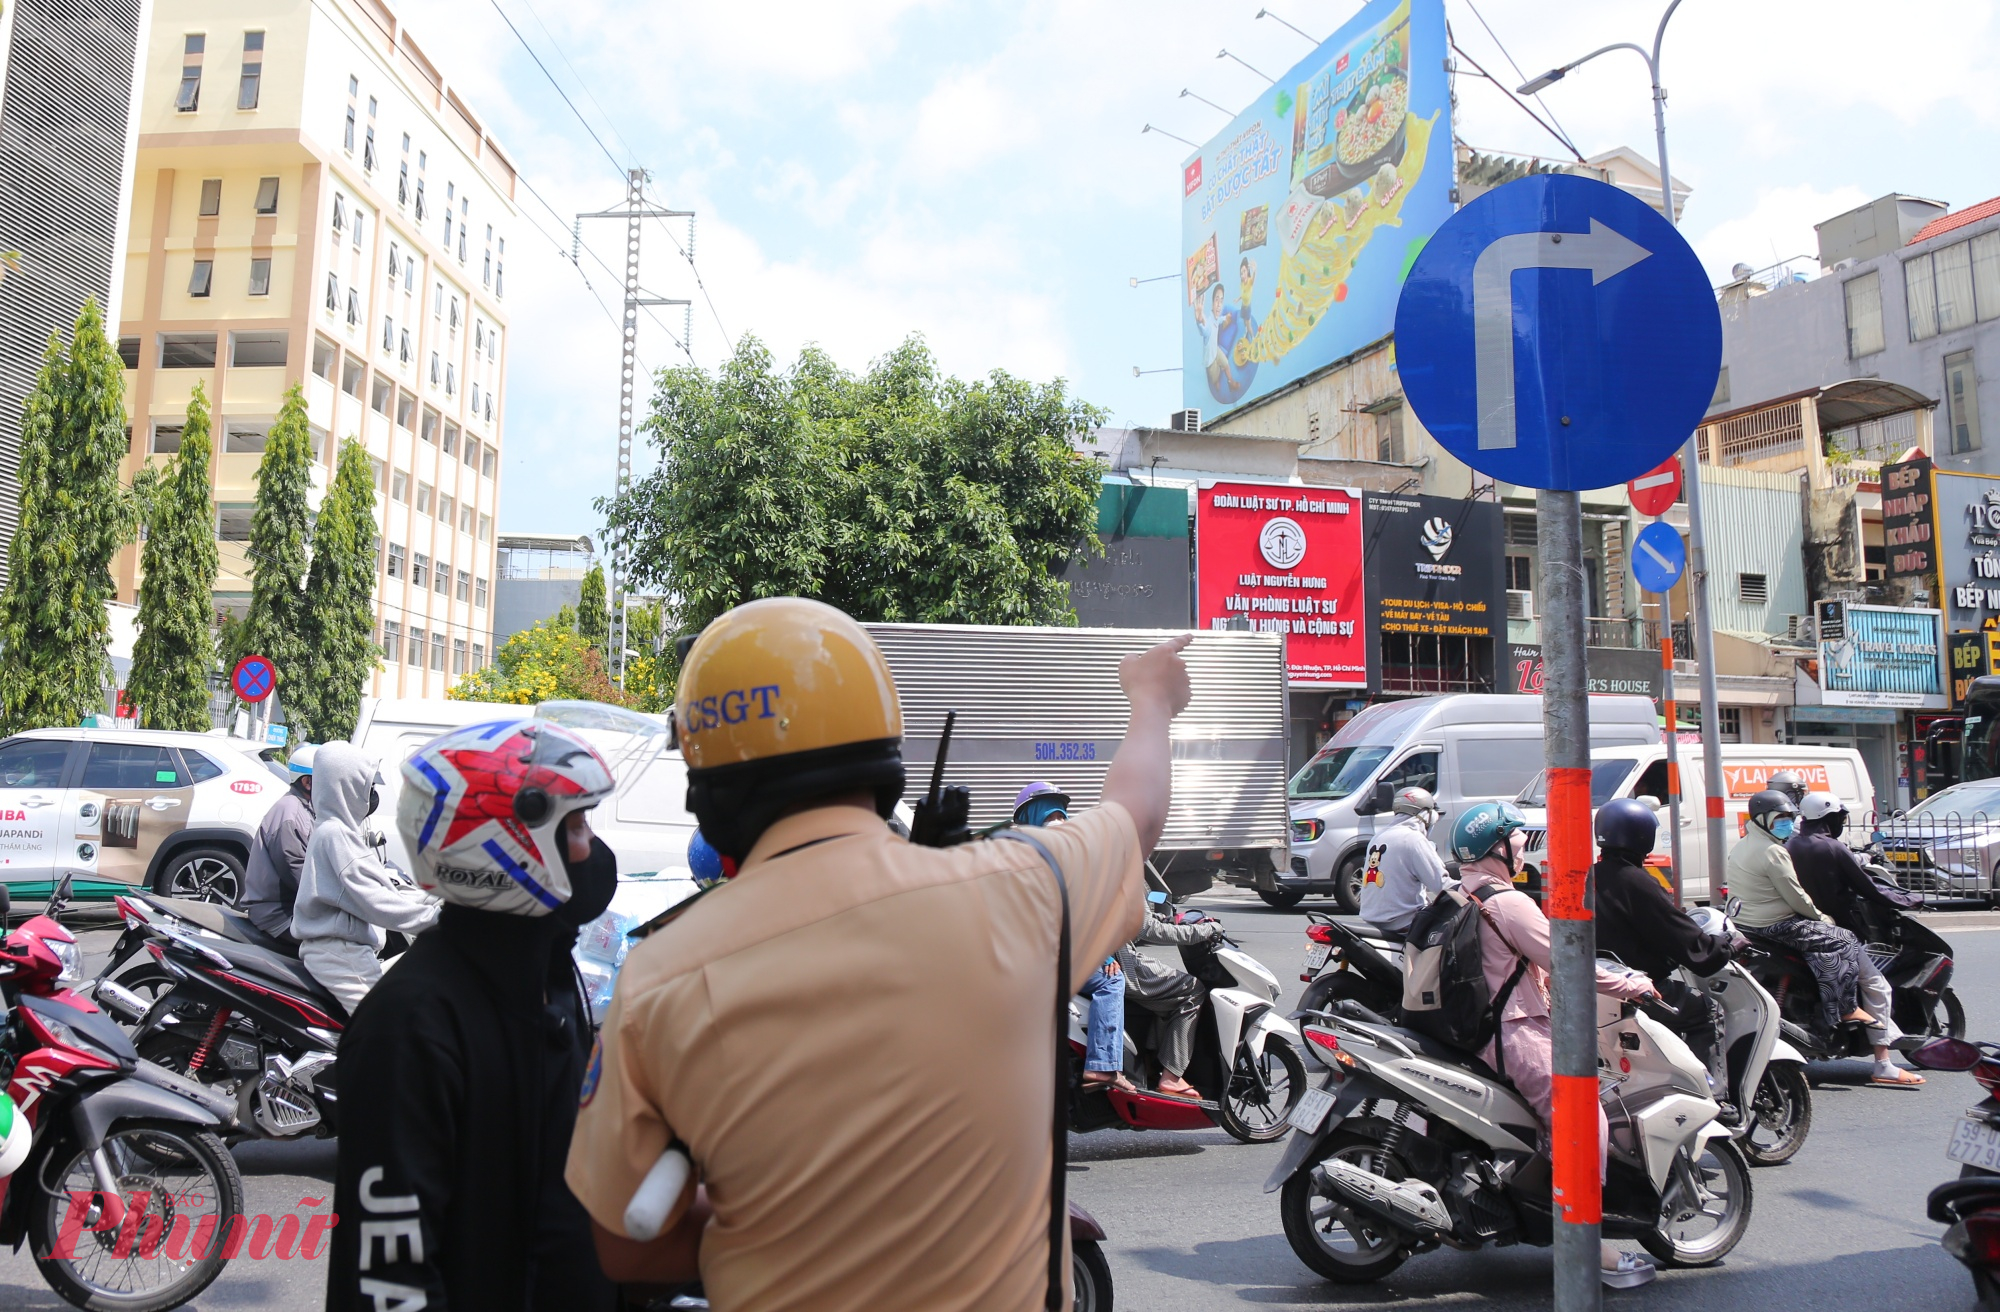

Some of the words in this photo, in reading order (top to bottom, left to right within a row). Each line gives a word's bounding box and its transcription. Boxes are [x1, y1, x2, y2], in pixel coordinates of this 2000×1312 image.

[1218, 149, 1238, 180] CHẤT
[1240, 131, 1268, 165] THẬT
[1186, 175, 1201, 192] VIFON
[1888, 465, 1920, 490] BẾP
[1213, 493, 1239, 508] ĐOÀN
[1240, 494, 1264, 513] LUẬT
[1266, 497, 1280, 510] SƯ
[1296, 494, 1309, 512] HỒ
[1309, 498, 1326, 514] CHÍ
[1326, 502, 1350, 515] MINH
[1884, 491, 1928, 517] NHẬP
[1886, 518, 1930, 546] KHẨU
[1893, 549, 1927, 572] ĐỨC
[1240, 573, 1262, 589] LUẬT
[1264, 573, 1300, 588] NGUYỄN
[1302, 576, 1327, 589] HƯNG
[1226, 593, 1250, 611] VĂN
[1252, 595, 1289, 613] PHÒNG
[1292, 596, 1320, 616] LUẬT
[1322, 598, 1338, 614] SƯ
[1384, 599, 1402, 607] TOUR
[1403, 600, 1414, 608] DU
[1414, 600, 1430, 610] LỊCH
[1433, 601, 1450, 610] VISA
[1453, 601, 1464, 612] HỘ
[1465, 601, 1487, 612] CHIẾU
[1956, 581, 1985, 608] BẾP
[1385, 609, 1394, 619] VÉ
[1394, 609, 1408, 619] MÁY
[1410, 612, 1423, 620] BAY
[1426, 611, 1436, 621] VÉ
[1436, 611, 1450, 622] TÀU
[1260, 617, 1290, 634] HƯNG
[1292, 616, 1307, 635] VÀ
[1308, 617, 1337, 638] CỘNG
[1339, 619, 1355, 638] SỰ
[1402, 623, 1419, 632] THUÊ
[1420, 624, 1429, 632] XE
[1433, 624, 1447, 634] ĐẶT
[1448, 625, 1473, 635] KHÁCH
[1474, 627, 1488, 637] SẠN
[1513, 646, 1539, 657] Hair
[1860, 641, 1895, 653] TRAVEL
[1898, 643, 1937, 655] TRACKS
[1954, 639, 1981, 669] BẾP
[1610, 679, 1651, 693] HOUSE
[686, 685, 781, 734] CSGT
[1035, 742, 1096, 760] 50H.352.35
[233, 782, 261, 793] 17639
[435, 863, 513, 890] ROYAL
